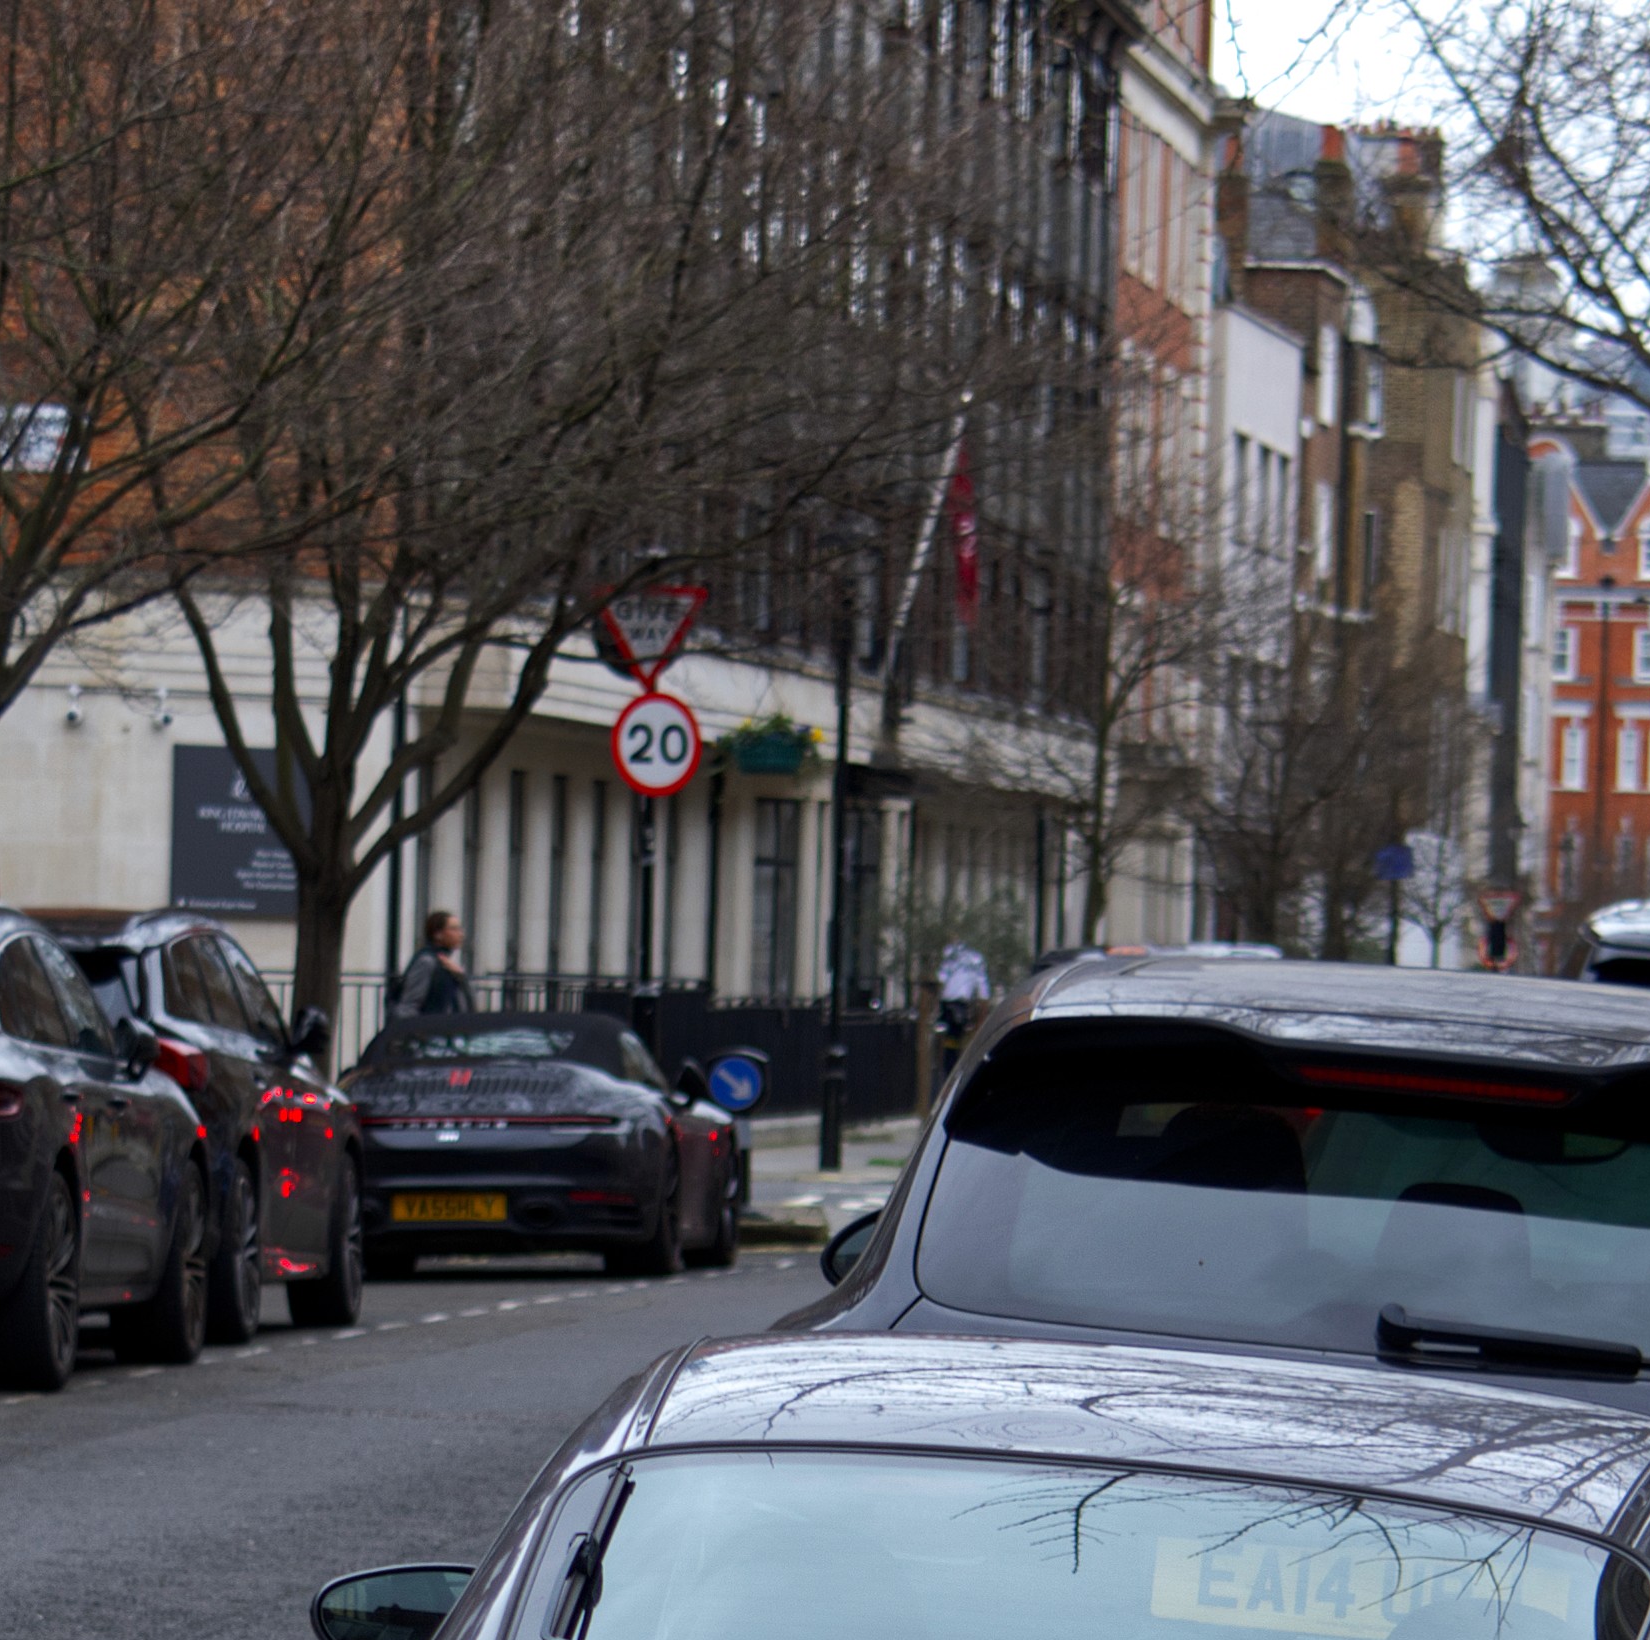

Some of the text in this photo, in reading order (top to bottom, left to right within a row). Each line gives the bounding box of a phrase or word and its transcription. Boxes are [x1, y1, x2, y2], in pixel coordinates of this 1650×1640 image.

[615, 601, 679, 621] GIVE
[627, 723, 689, 765] 20
[1197, 1541, 1356, 1620] EA14
